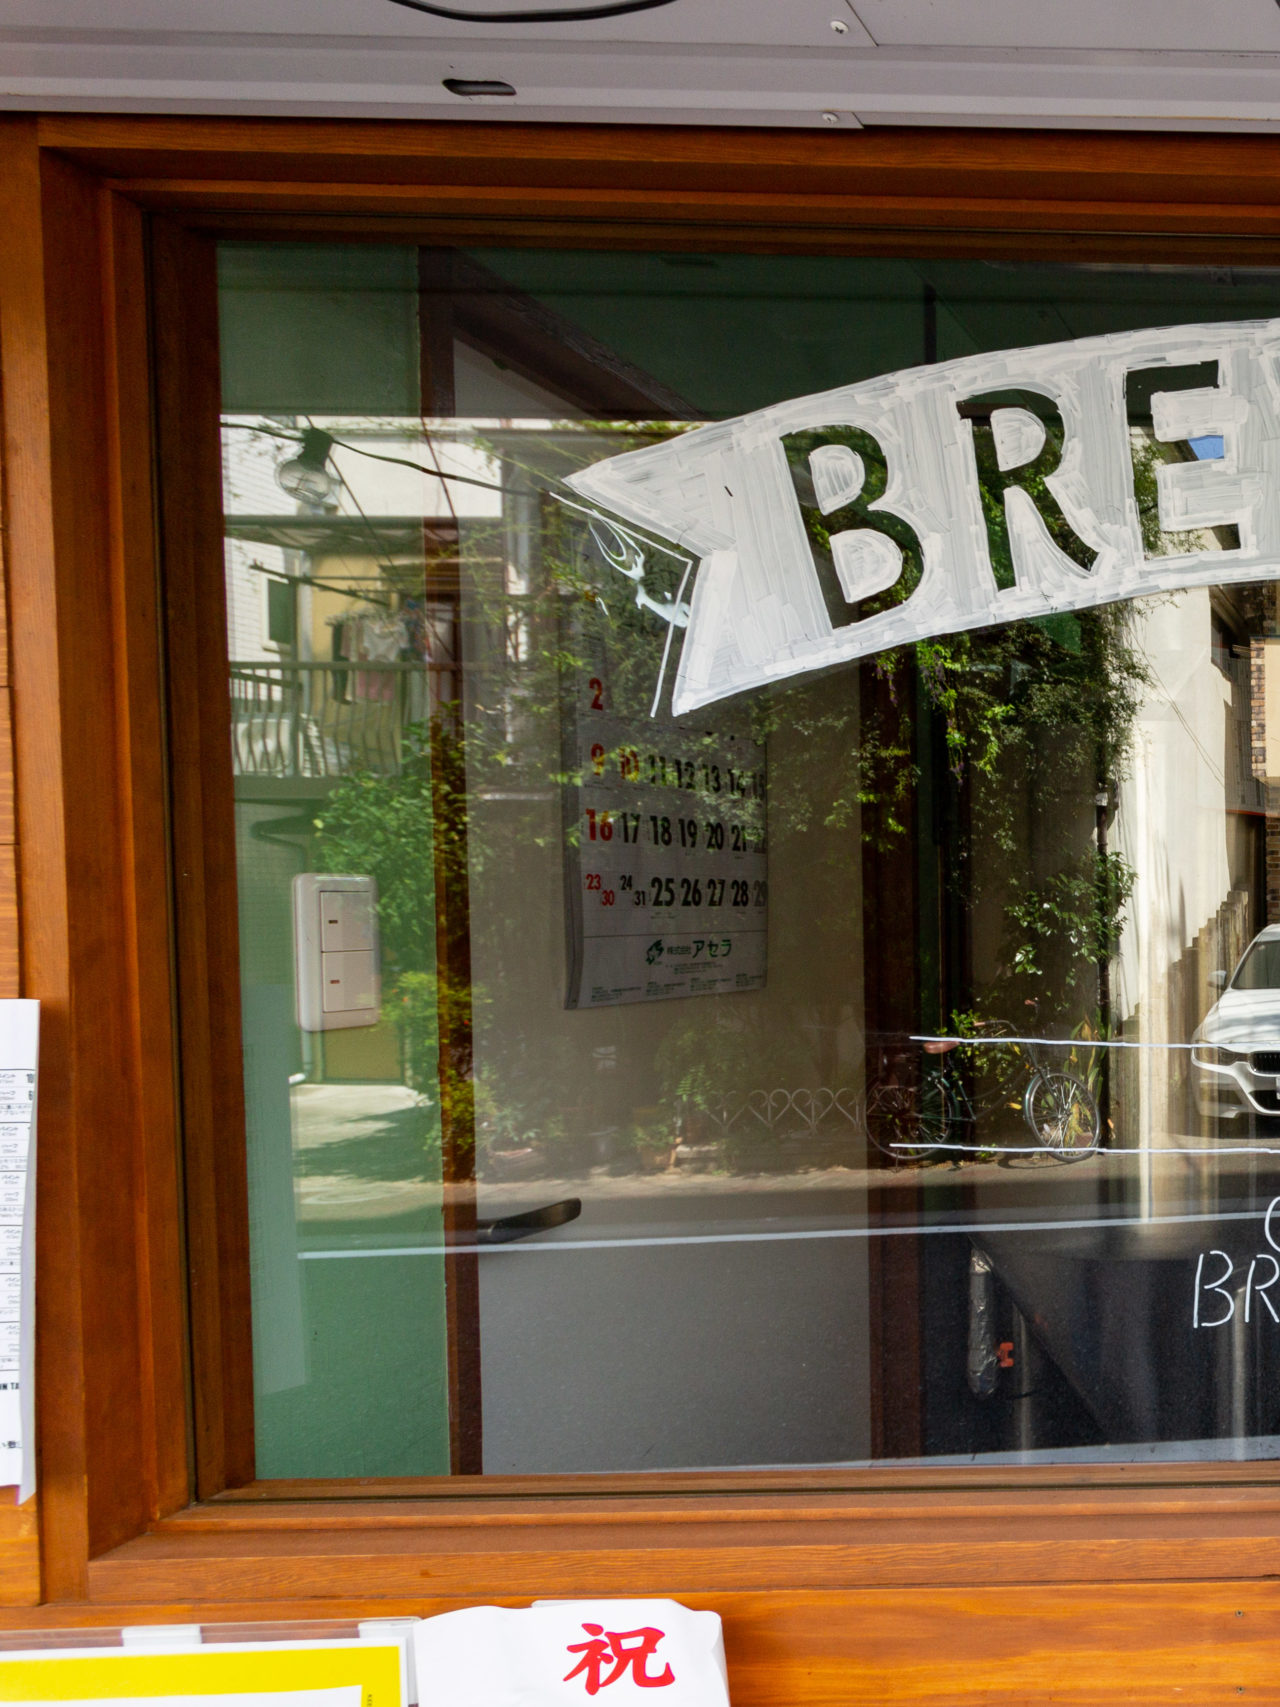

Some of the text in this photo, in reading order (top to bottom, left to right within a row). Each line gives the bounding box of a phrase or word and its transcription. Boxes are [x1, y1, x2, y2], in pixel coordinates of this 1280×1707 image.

[589, 677, 604, 711] 2
[590, 743, 605, 777] 9
[619, 746, 640, 782] 10
[649, 754, 668, 787] 11
[675, 758, 697, 791] 12
[702, 764, 721, 794] 13
[586, 808, 613, 842] 16
[621, 812, 641, 844] 17
[650, 815, 672, 846] 18
[678, 819, 698, 848] 19
[705, 822, 725, 851] 20
[731, 825, 748, 853] 21
[586, 874, 602, 891] 23
[620, 874, 633, 891] 24
[651, 877, 676, 907] 25
[680, 878, 702, 907] 26
[707, 879, 726, 907] 27
[731, 879, 750, 907] 28
[601, 889, 646, 906] 30 31
[562, 1622, 677, 1696] 祝
